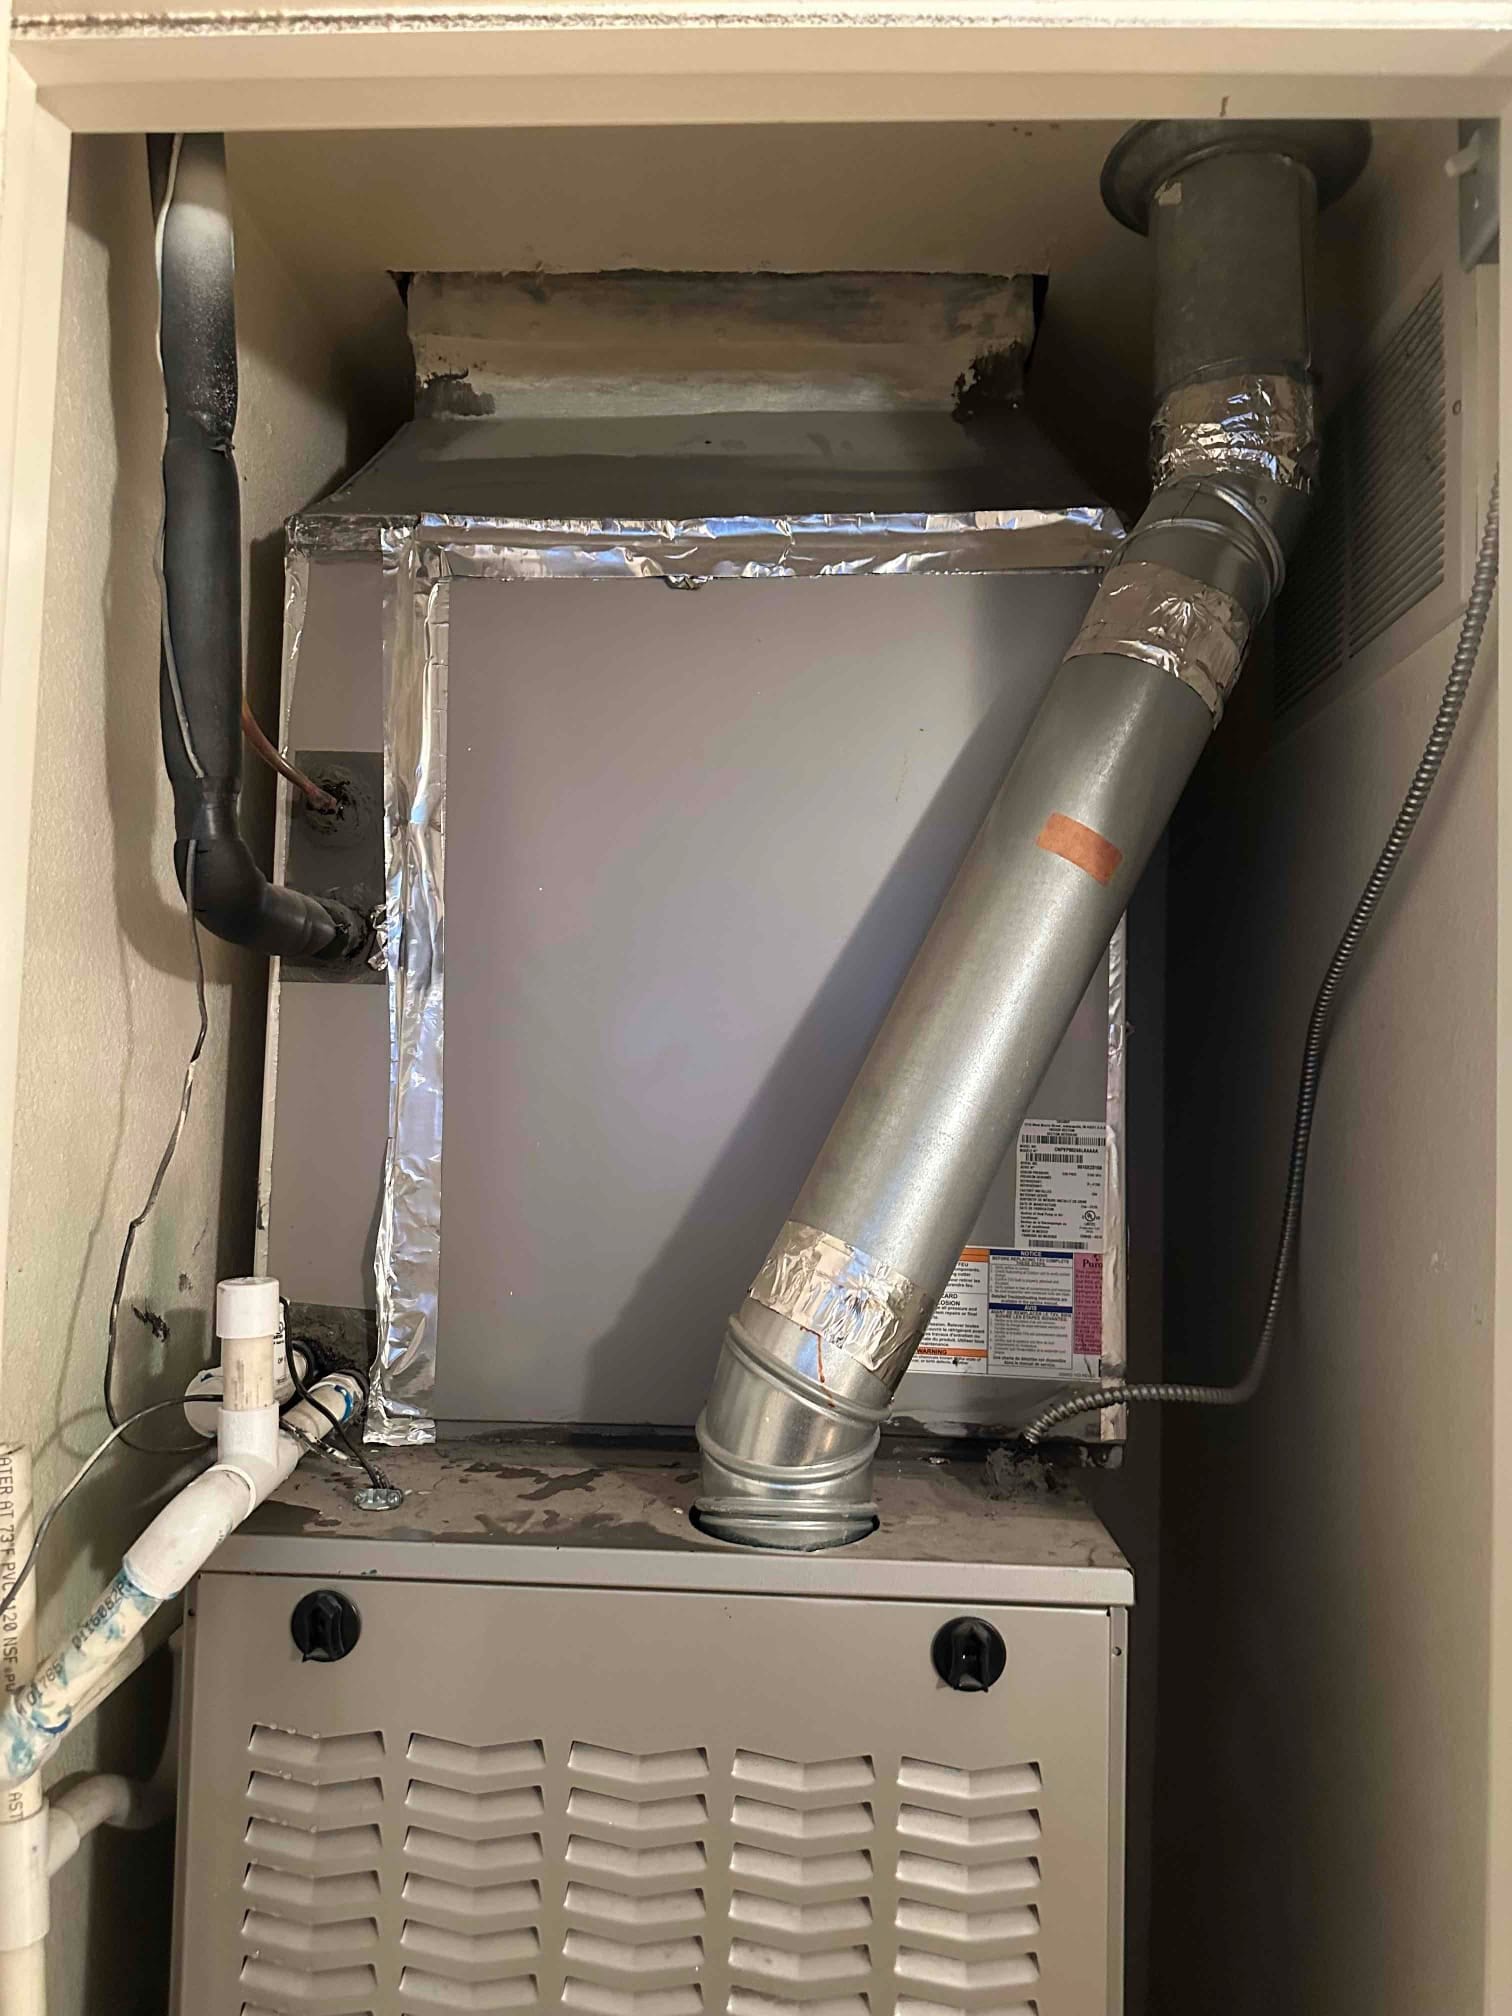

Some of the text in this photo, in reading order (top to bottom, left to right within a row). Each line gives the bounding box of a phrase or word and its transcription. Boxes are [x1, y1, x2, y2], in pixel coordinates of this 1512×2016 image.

[0, 1457, 13, 1495] ATER
[0, 1500, 14, 1518] AT
[2, 1561, 16, 1590] PVC
[3, 1636, 18, 1664] NSF
